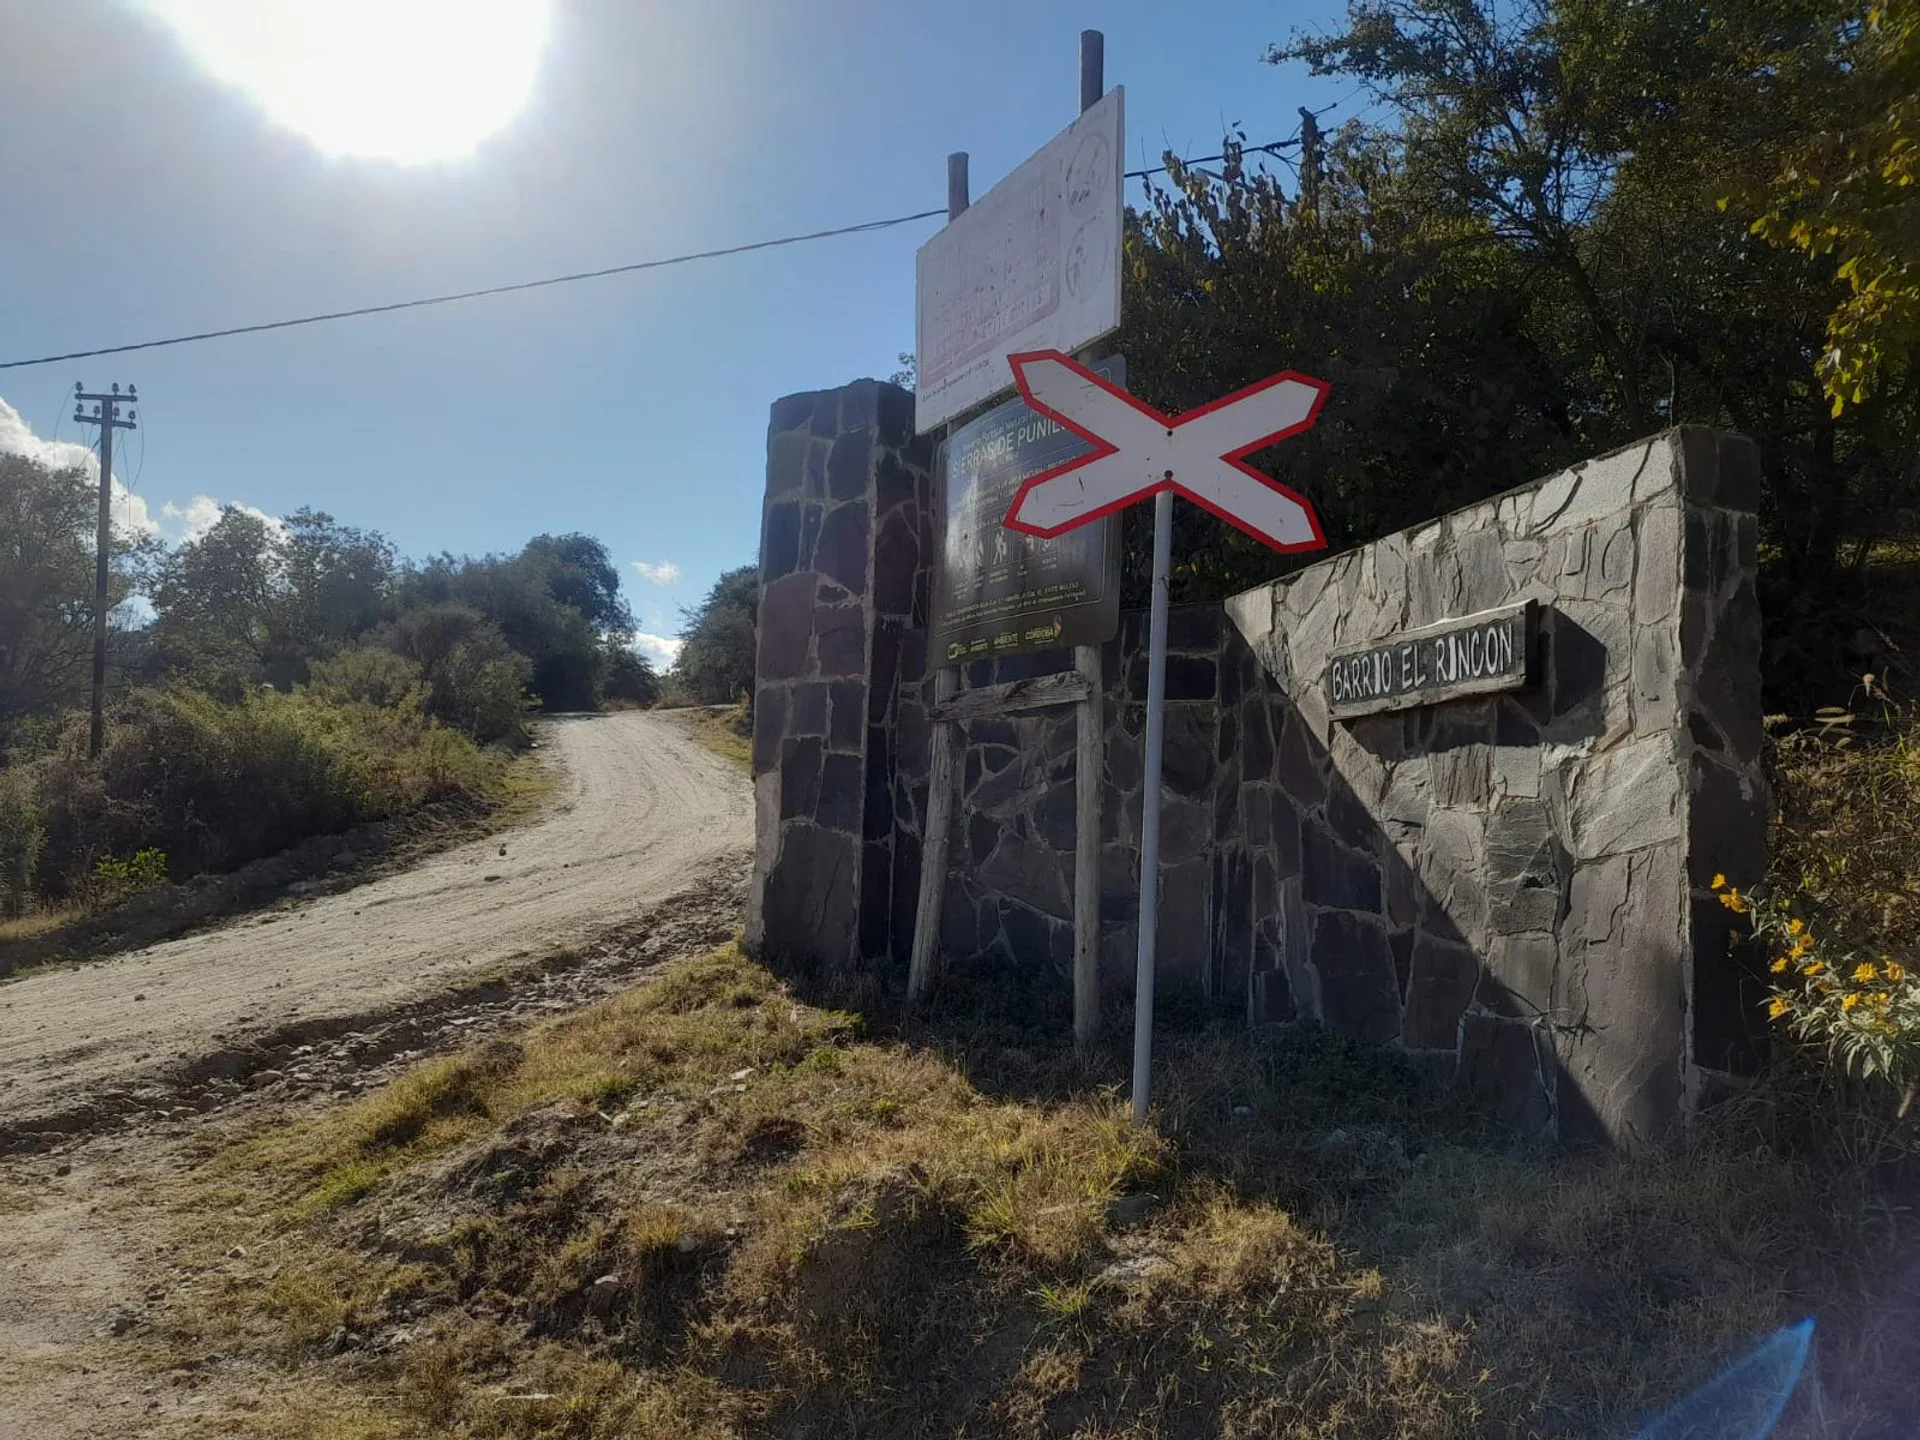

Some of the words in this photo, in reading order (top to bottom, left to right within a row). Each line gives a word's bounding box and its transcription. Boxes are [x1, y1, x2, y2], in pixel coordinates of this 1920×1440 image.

[953, 443, 996, 479] SIERRAS
[998, 432, 1014, 456] DE
[1333, 652, 1392, 701] BARRIO
[1402, 646, 1426, 689] EL
[1436, 623, 1512, 681] RINCON
